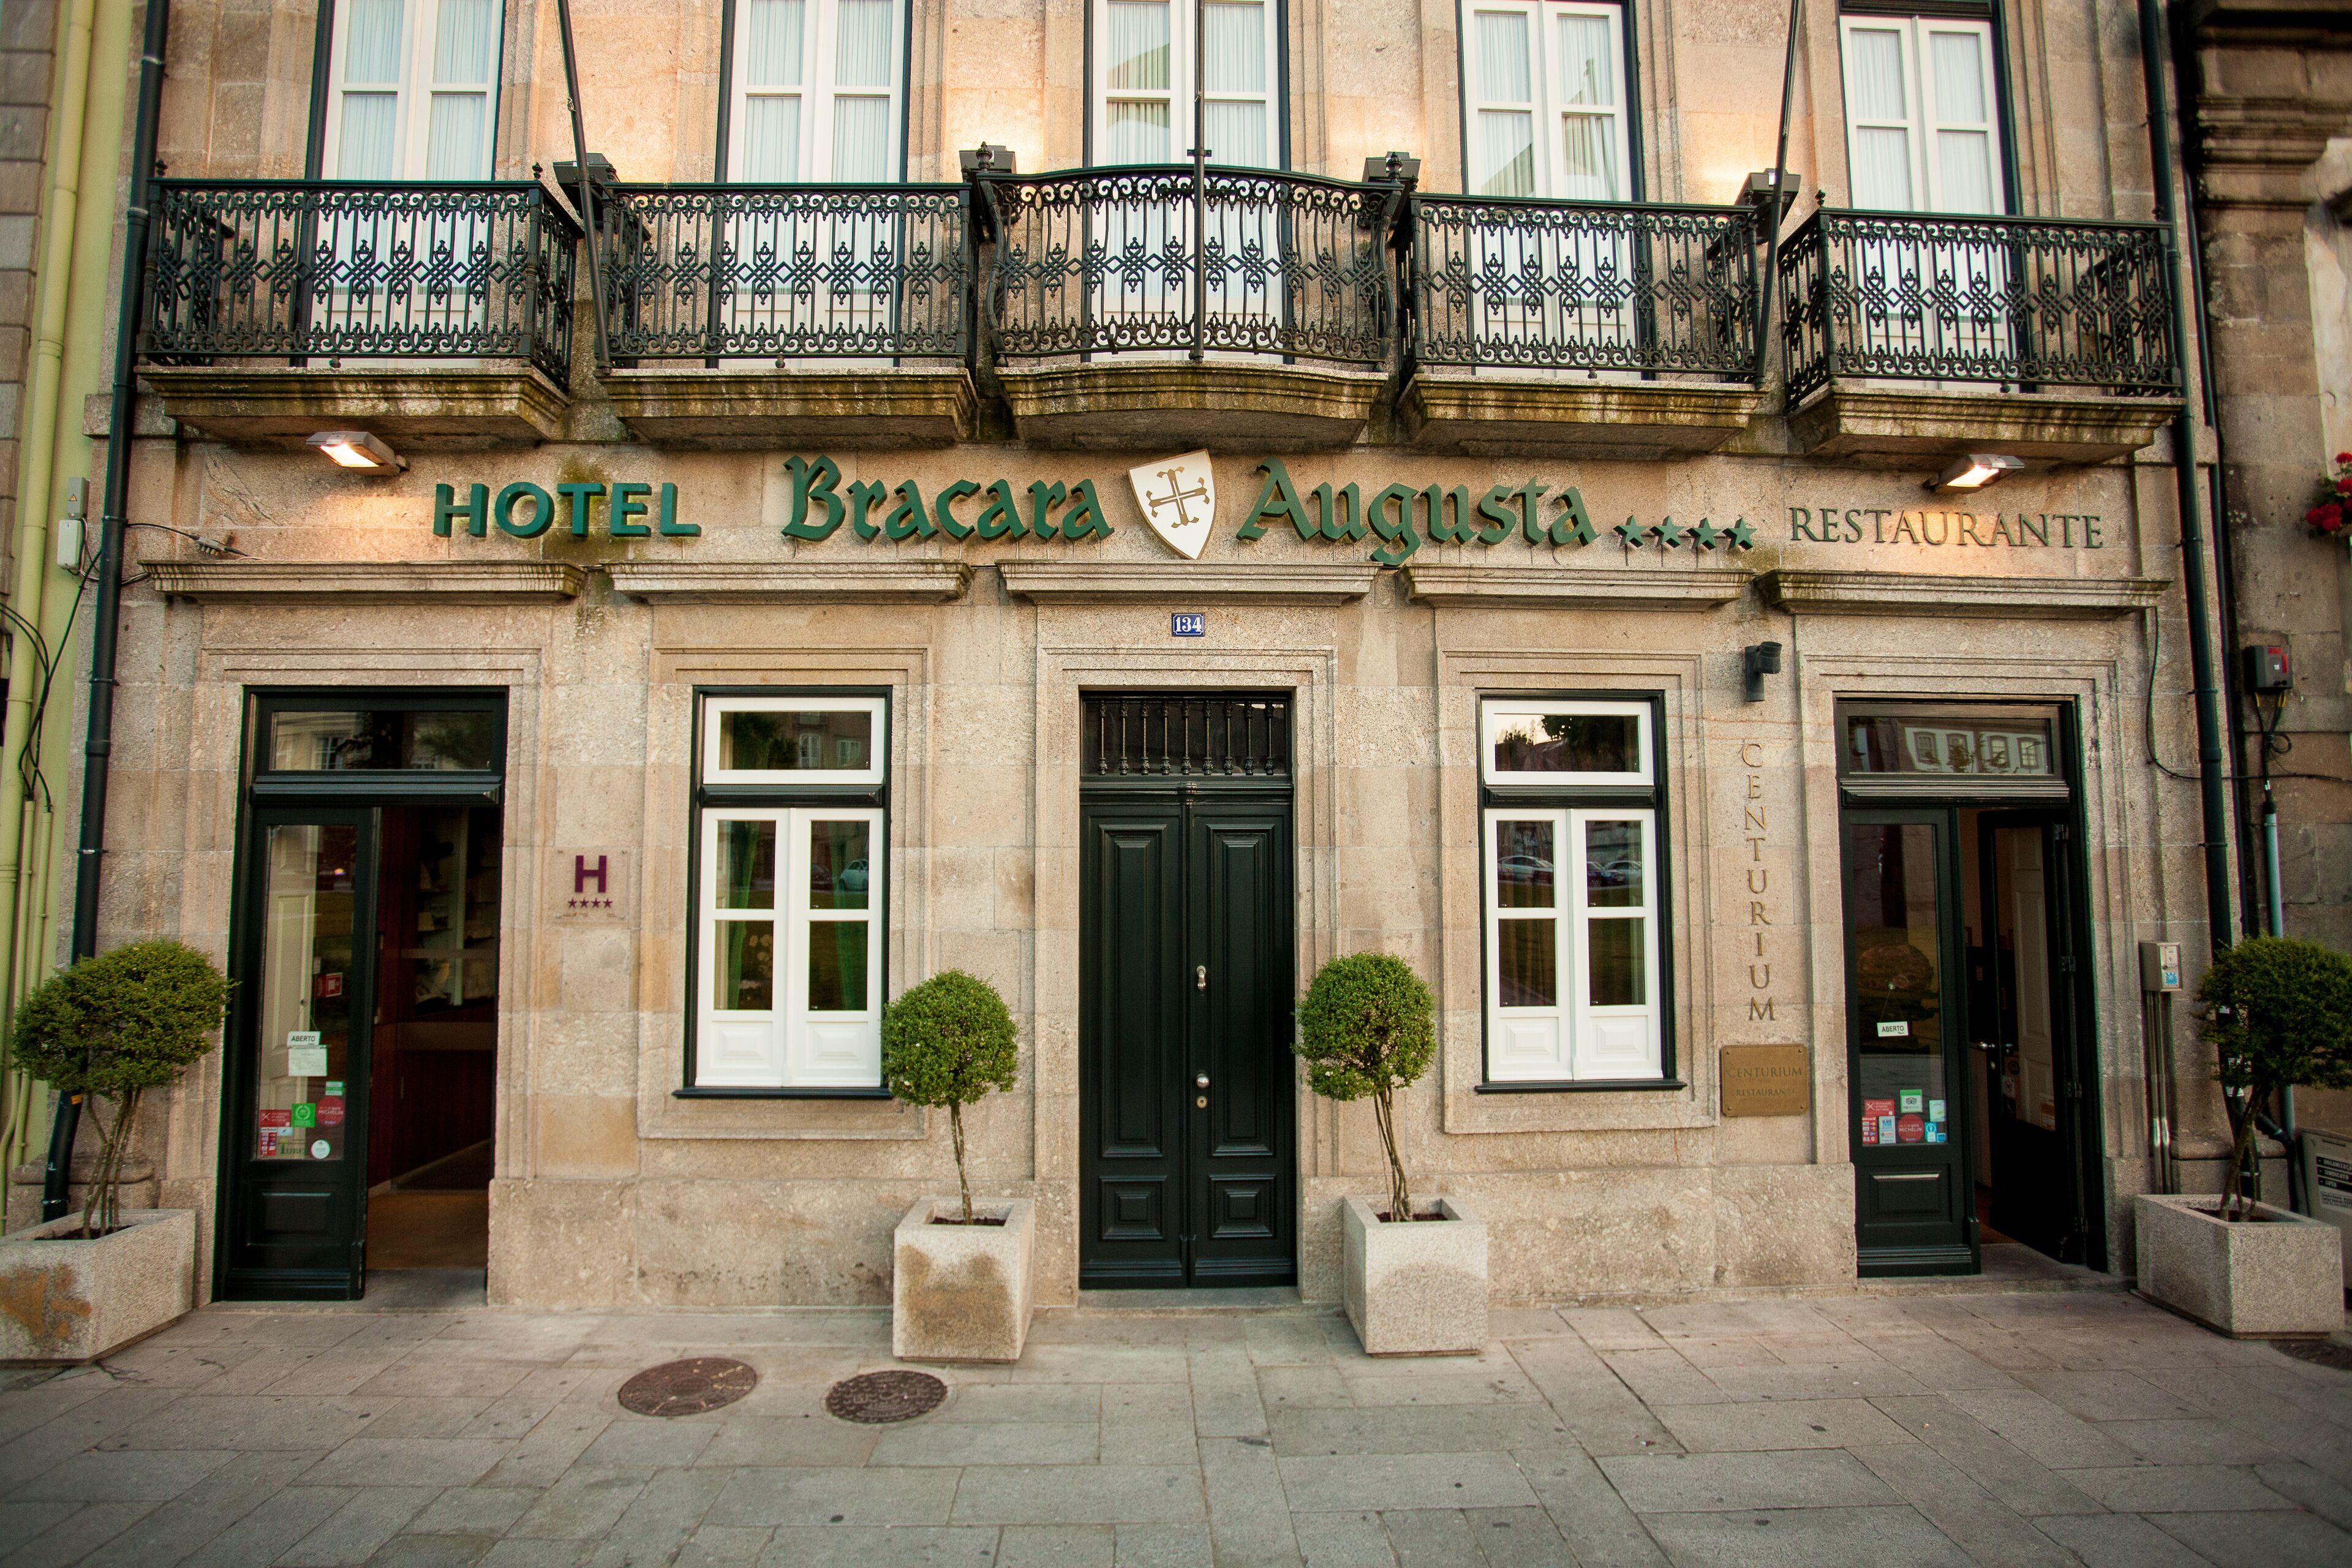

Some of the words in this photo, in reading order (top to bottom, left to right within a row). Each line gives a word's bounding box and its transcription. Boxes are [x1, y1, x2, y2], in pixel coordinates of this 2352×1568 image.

[432, 481, 702, 539] HOTEL
[782, 454, 1115, 542] Bracara
[1235, 456, 1602, 567] Augusta
[1789, 507, 2104, 549] RESTAURANTE
[1175, 617, 1202, 632] 134
[575, 855, 607, 893] H
[1741, 742, 1776, 1022] CENTURIUM
[1728, 1067, 1802, 1078] CENTURIUM
